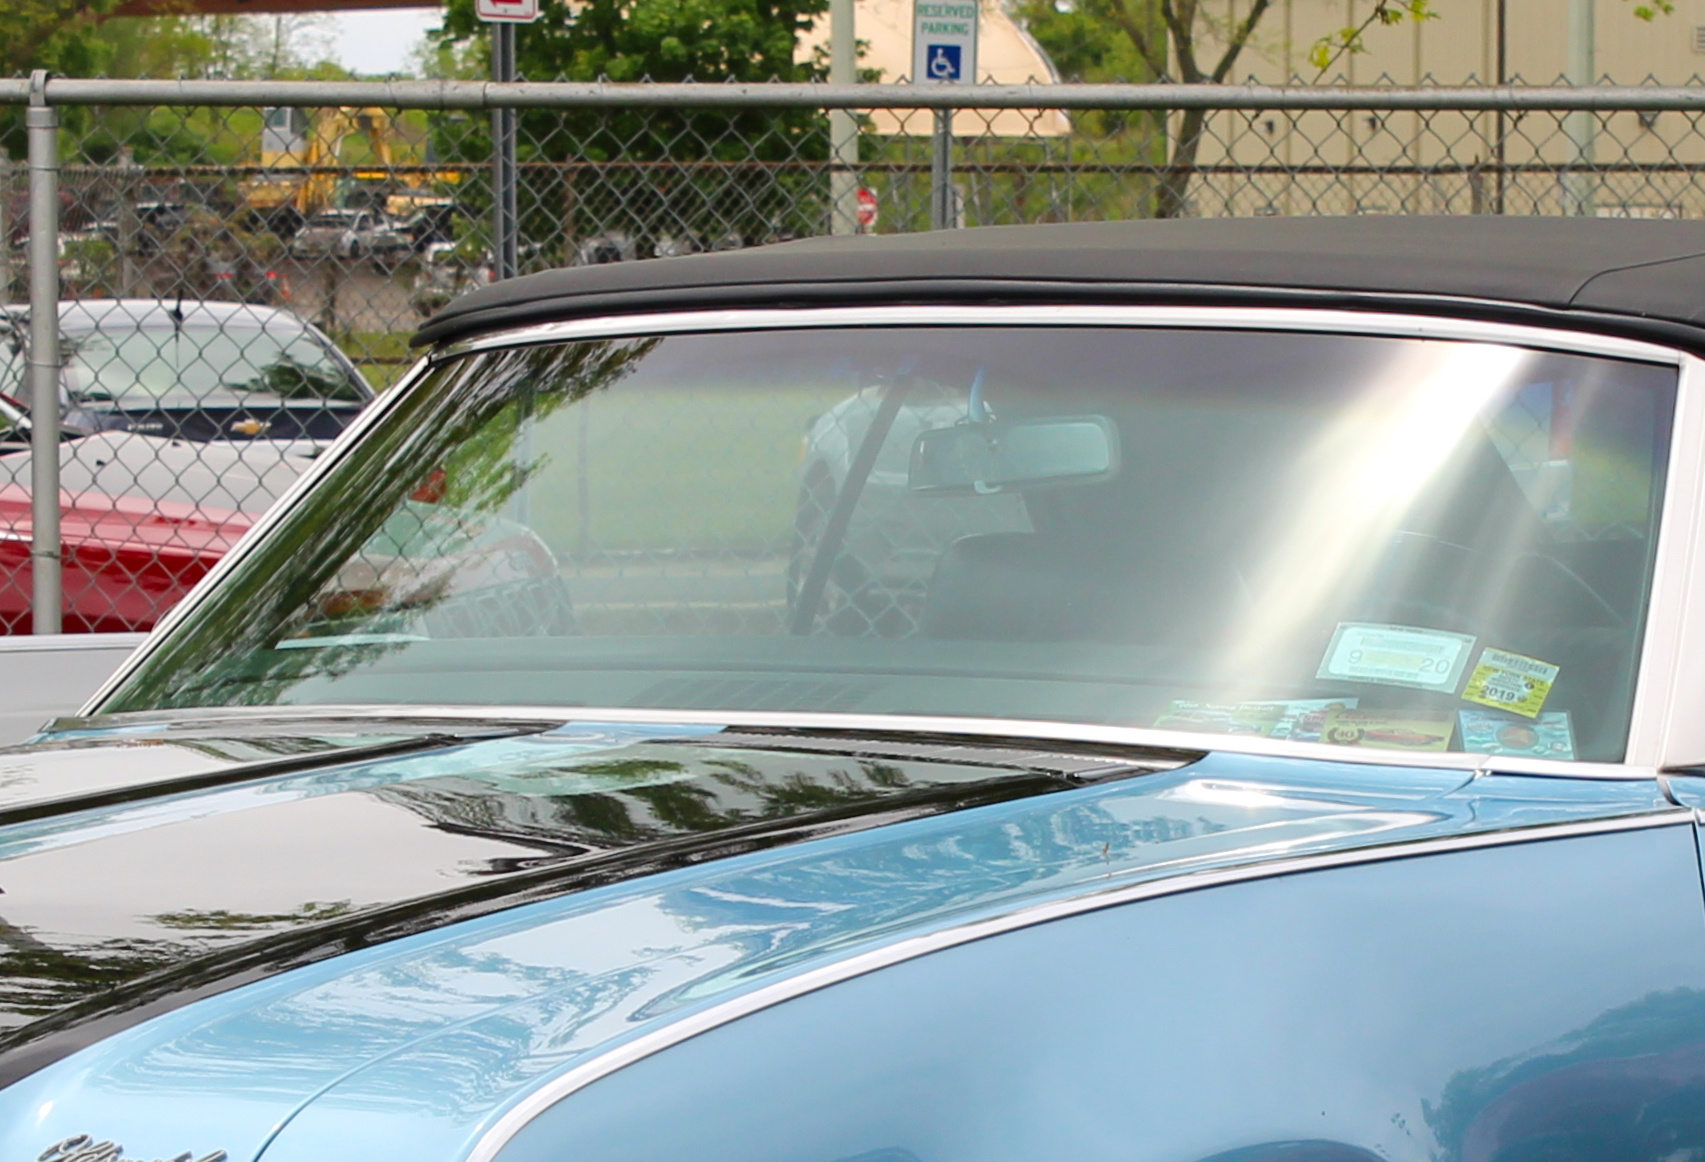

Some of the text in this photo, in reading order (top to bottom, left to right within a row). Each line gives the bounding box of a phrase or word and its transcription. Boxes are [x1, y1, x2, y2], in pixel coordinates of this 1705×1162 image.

[917, 4, 974, 18] RESERVED
[921, 22, 969, 35] PARKING
[1348, 650, 1363, 665] 9
[1419, 657, 1451, 675] 20
[1483, 685, 1515, 701] 2019
